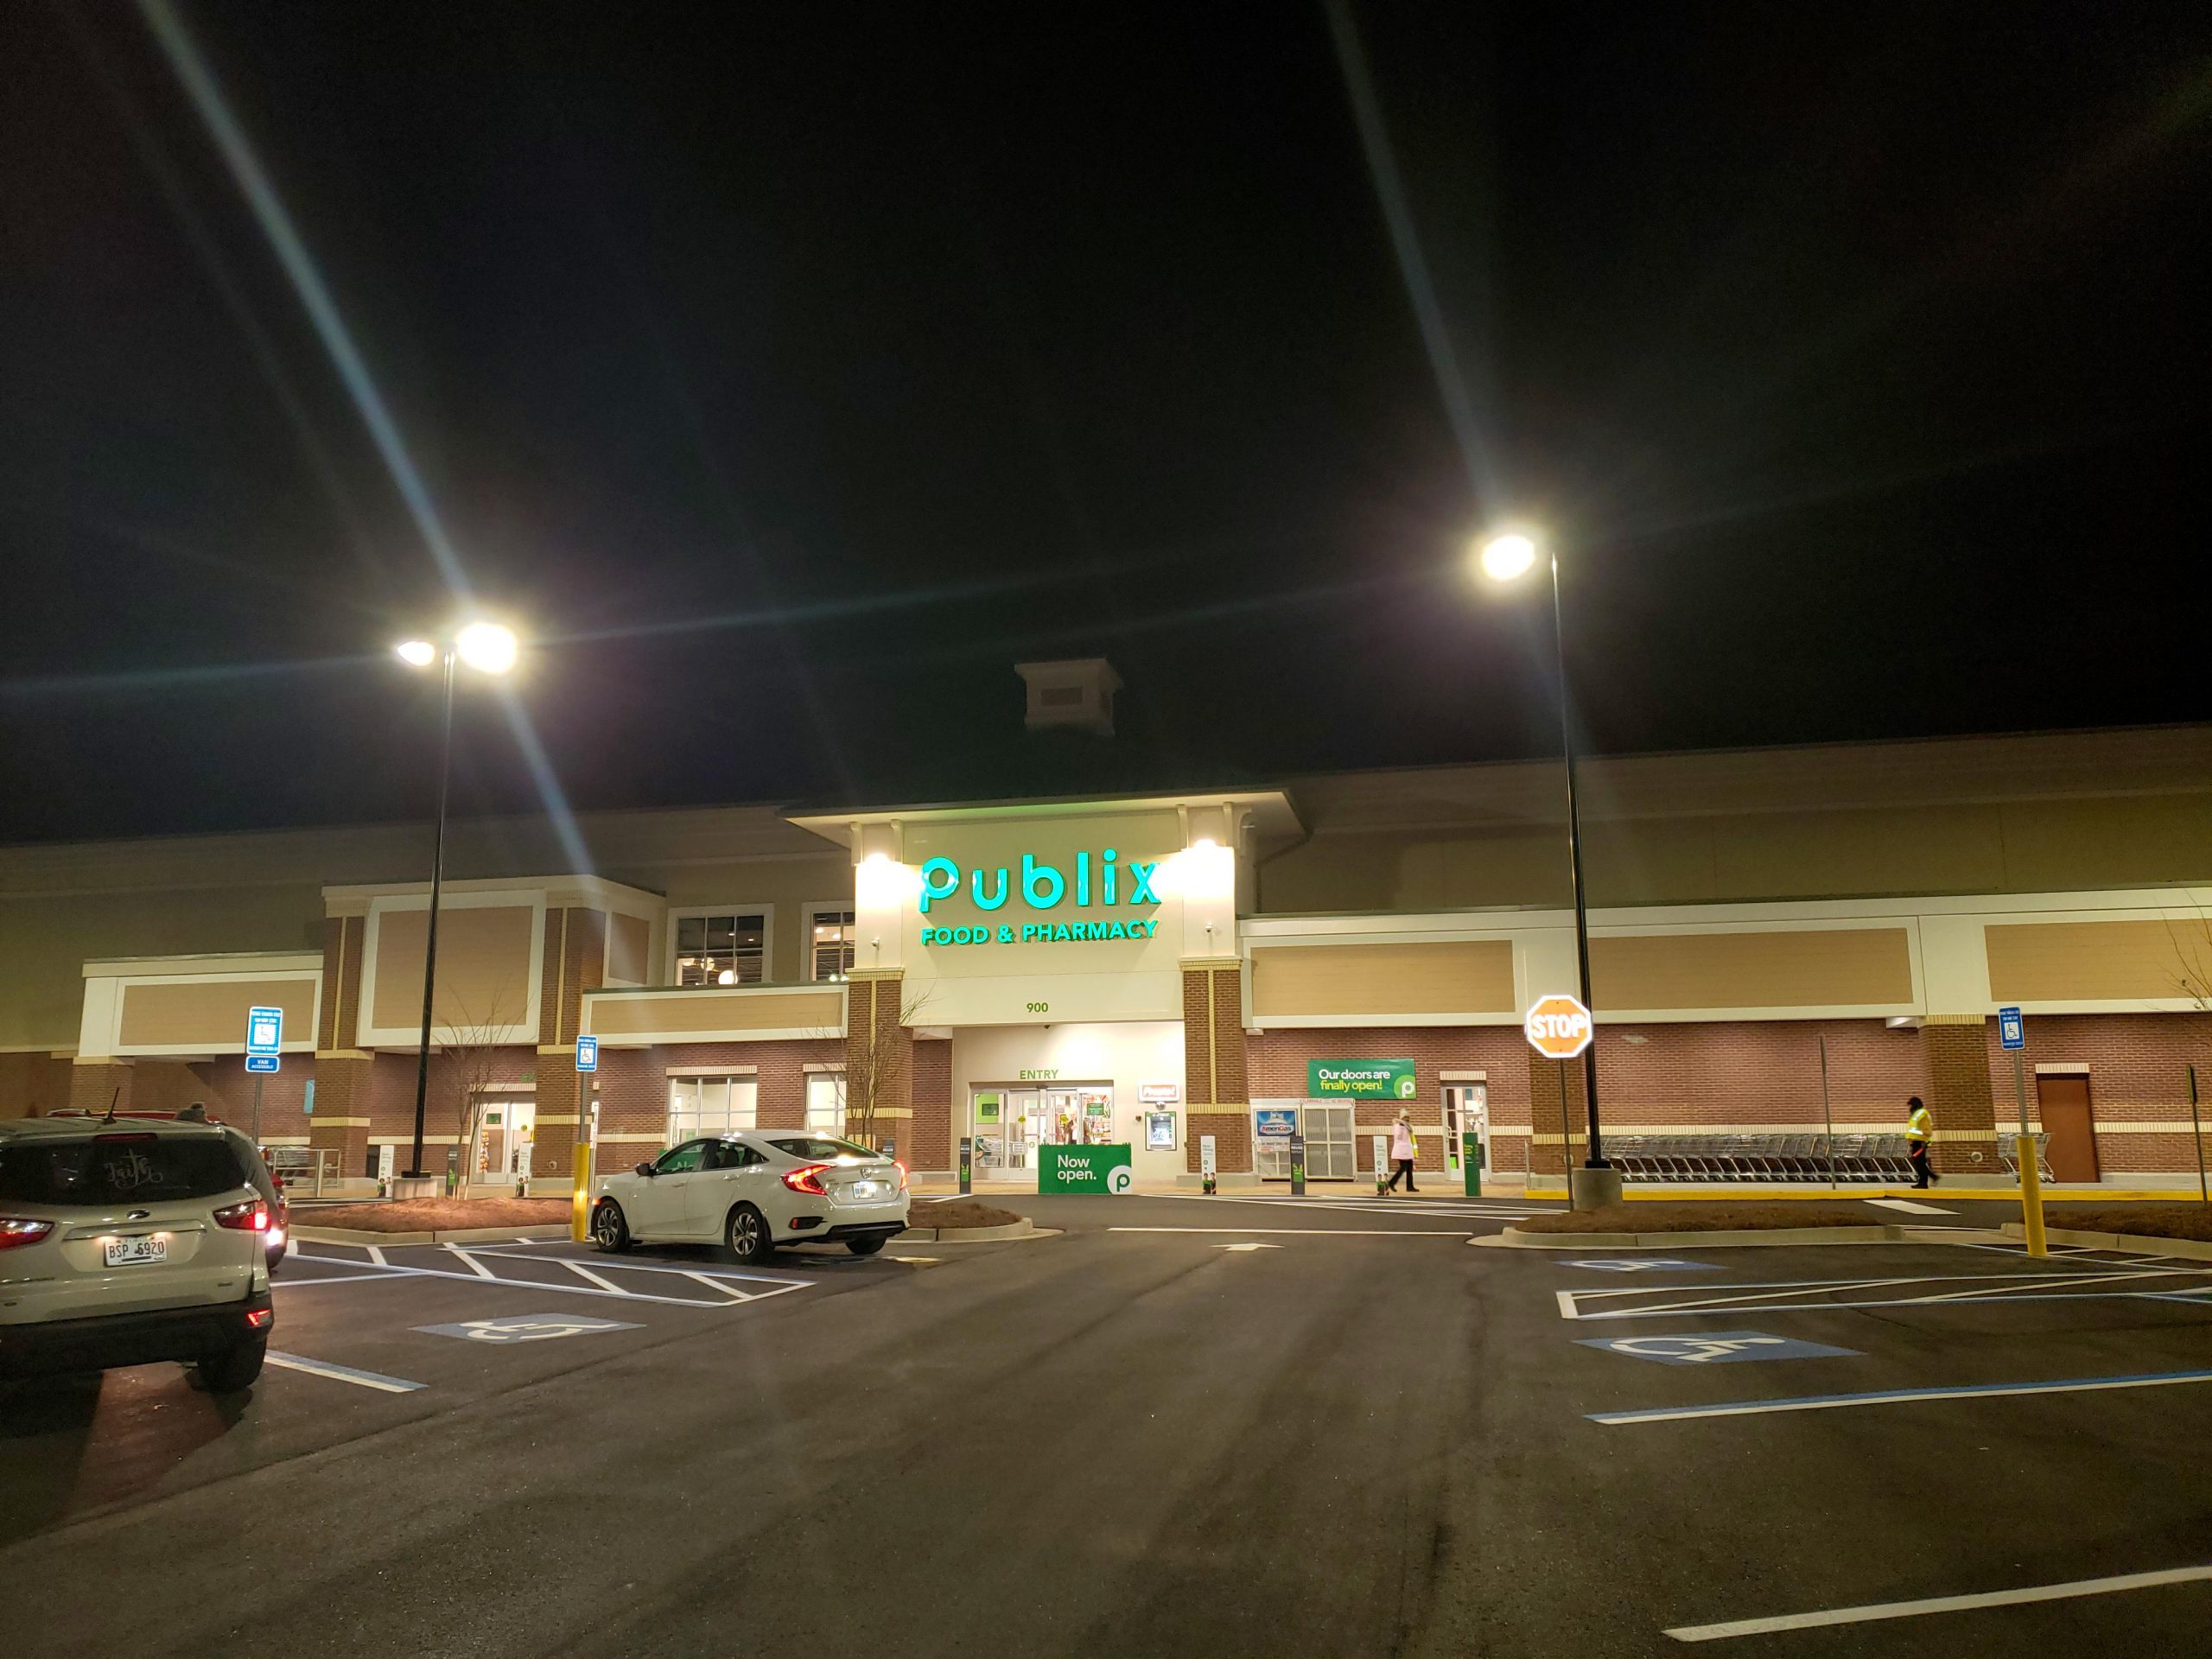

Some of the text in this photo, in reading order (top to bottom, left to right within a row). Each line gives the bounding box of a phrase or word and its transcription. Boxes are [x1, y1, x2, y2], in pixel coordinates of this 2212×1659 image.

[918, 848, 1161, 912] Publix
[921, 919, 1159, 945] FOOD & PHARMACY
[1027, 1002, 1049, 1013] 900
[1531, 1014, 1587, 1039] STOP
[1020, 1070, 1058, 1079] ENTRY
[1319, 1069, 1339, 1079] Our
[1341, 1069, 1372, 1079] doors
[1320, 1080, 1382, 1092] finally open!
[1057, 1154, 1090, 1168] Now
[1057, 1170, 1097, 1184] open.
[109, 1242, 164, 1258] BSP 6920
